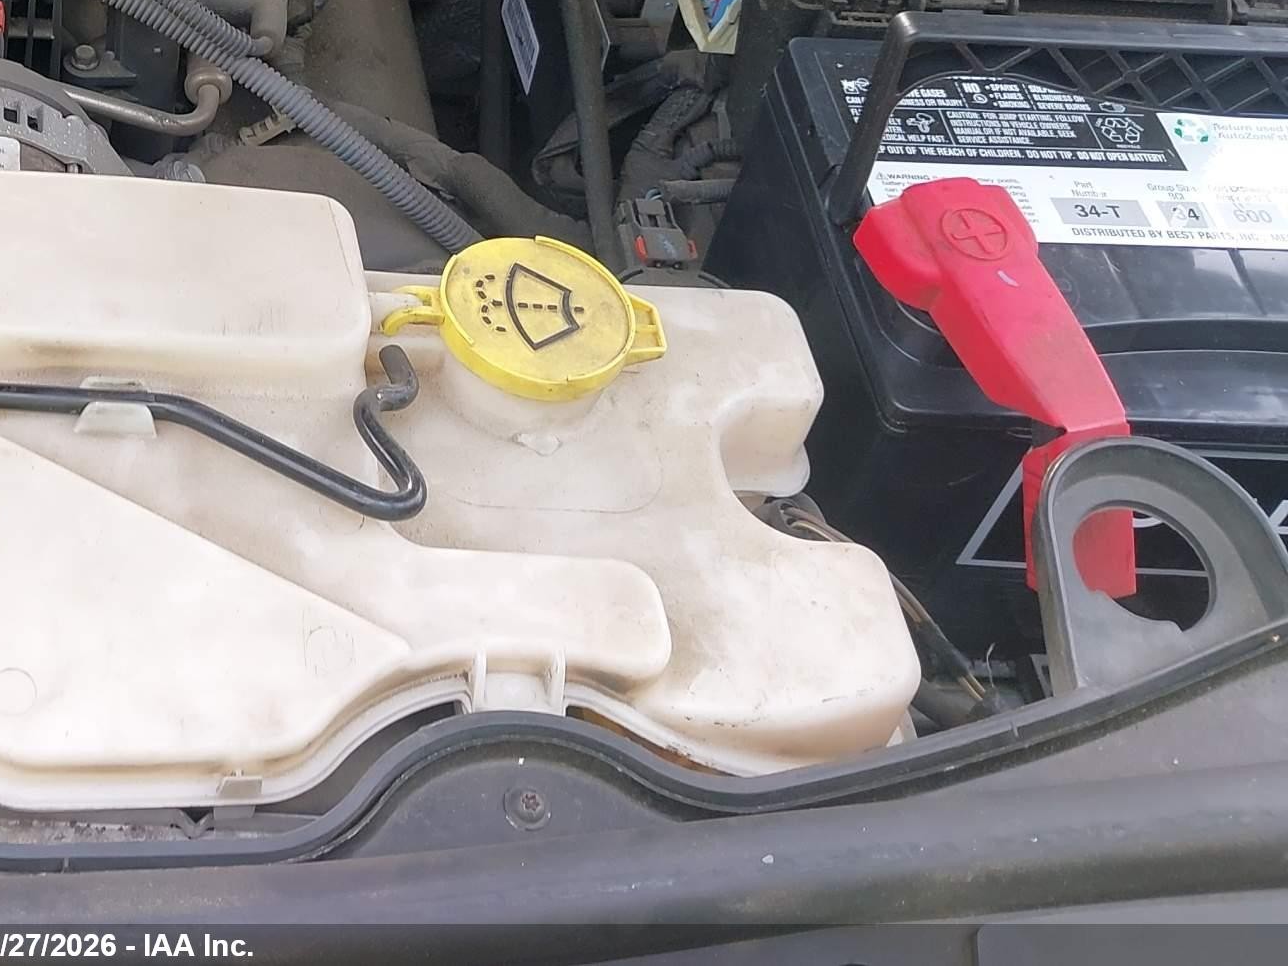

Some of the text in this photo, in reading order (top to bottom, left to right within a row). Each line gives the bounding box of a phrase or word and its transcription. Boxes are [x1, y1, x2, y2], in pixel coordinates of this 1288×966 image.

[962, 82, 980, 93] NO
[920, 89, 947, 98] GASES
[1032, 94, 1073, 102] BLINDNESS
[925, 99, 937, 107] OR
[998, 100, 1031, 108] SMOKING
[1036, 102, 1066, 110] SEVERE
[946, 111, 981, 119] CAUTION:
[998, 112, 1017, 120] JUMP
[1055, 115, 1085, 123] FOLLOW
[1011, 121, 1038, 129] VEHICLE
[1018, 130, 1058, 138] AVAILABLE,
[926, 135, 950, 143] FAST.
[886, 146, 905, 154] OUT
[905, 146, 917, 154] OF
[918, 147, 937, 156] THE
[936, 148, 966, 156] REACH
[966, 148, 978, 156] OF
[978, 149, 1024, 158] CHILDREN.
[1026, 150, 1040, 158] DO
[1041, 151, 1058, 159] NOT
[1058, 152, 1076, 160] TIP.
[1078, 152, 1090, 160] DO
[1091, 152, 1108, 161] NOT
[1108, 152, 1130, 162] OPEN
[1130, 153, 1167, 162] BATTERY!
[1074, 204, 1120, 218] 34-T
[1172, 208, 1200, 220] 34
[1233, 209, 1272, 223] 600
[1072, 228, 1146, 238] DISTRIBUTED
[1148, 230, 1163, 238] BY
[1166, 230, 1195, 239] BEST
